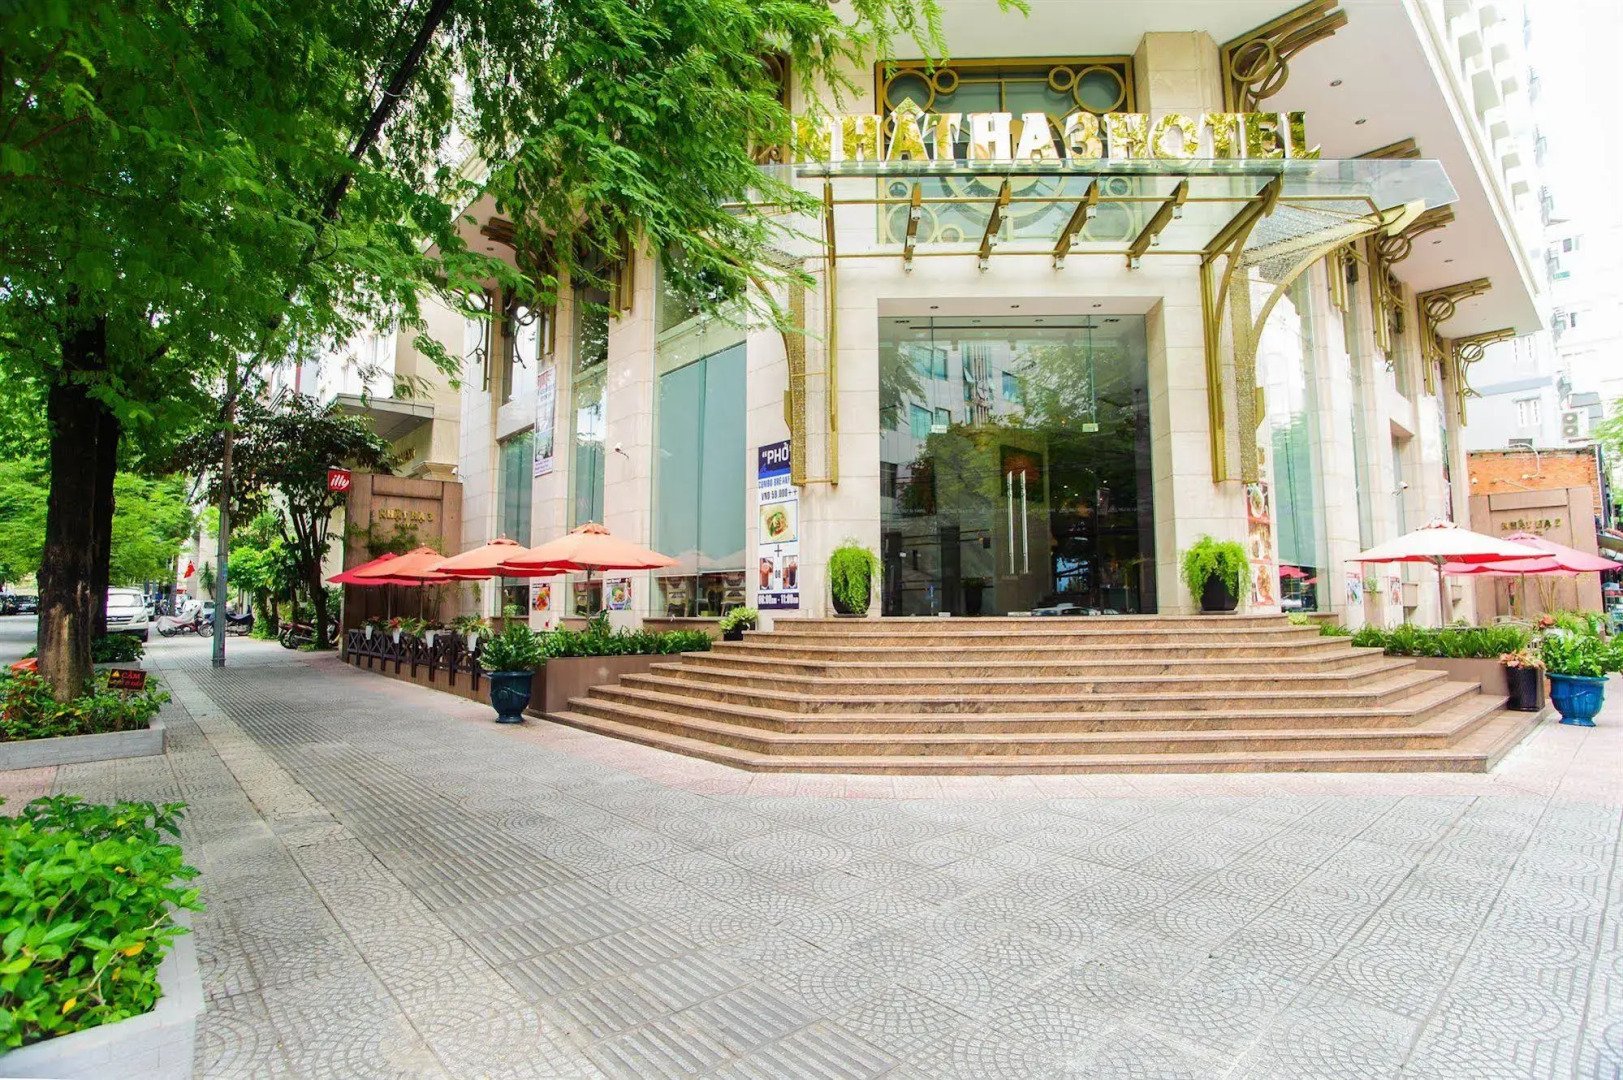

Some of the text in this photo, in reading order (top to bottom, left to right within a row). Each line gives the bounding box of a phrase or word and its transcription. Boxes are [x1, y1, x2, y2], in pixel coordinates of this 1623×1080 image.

[1065, 112, 1103, 169] 3
[1103, 111, 1322, 168] HOTEL
[330, 474, 349, 490] illy
